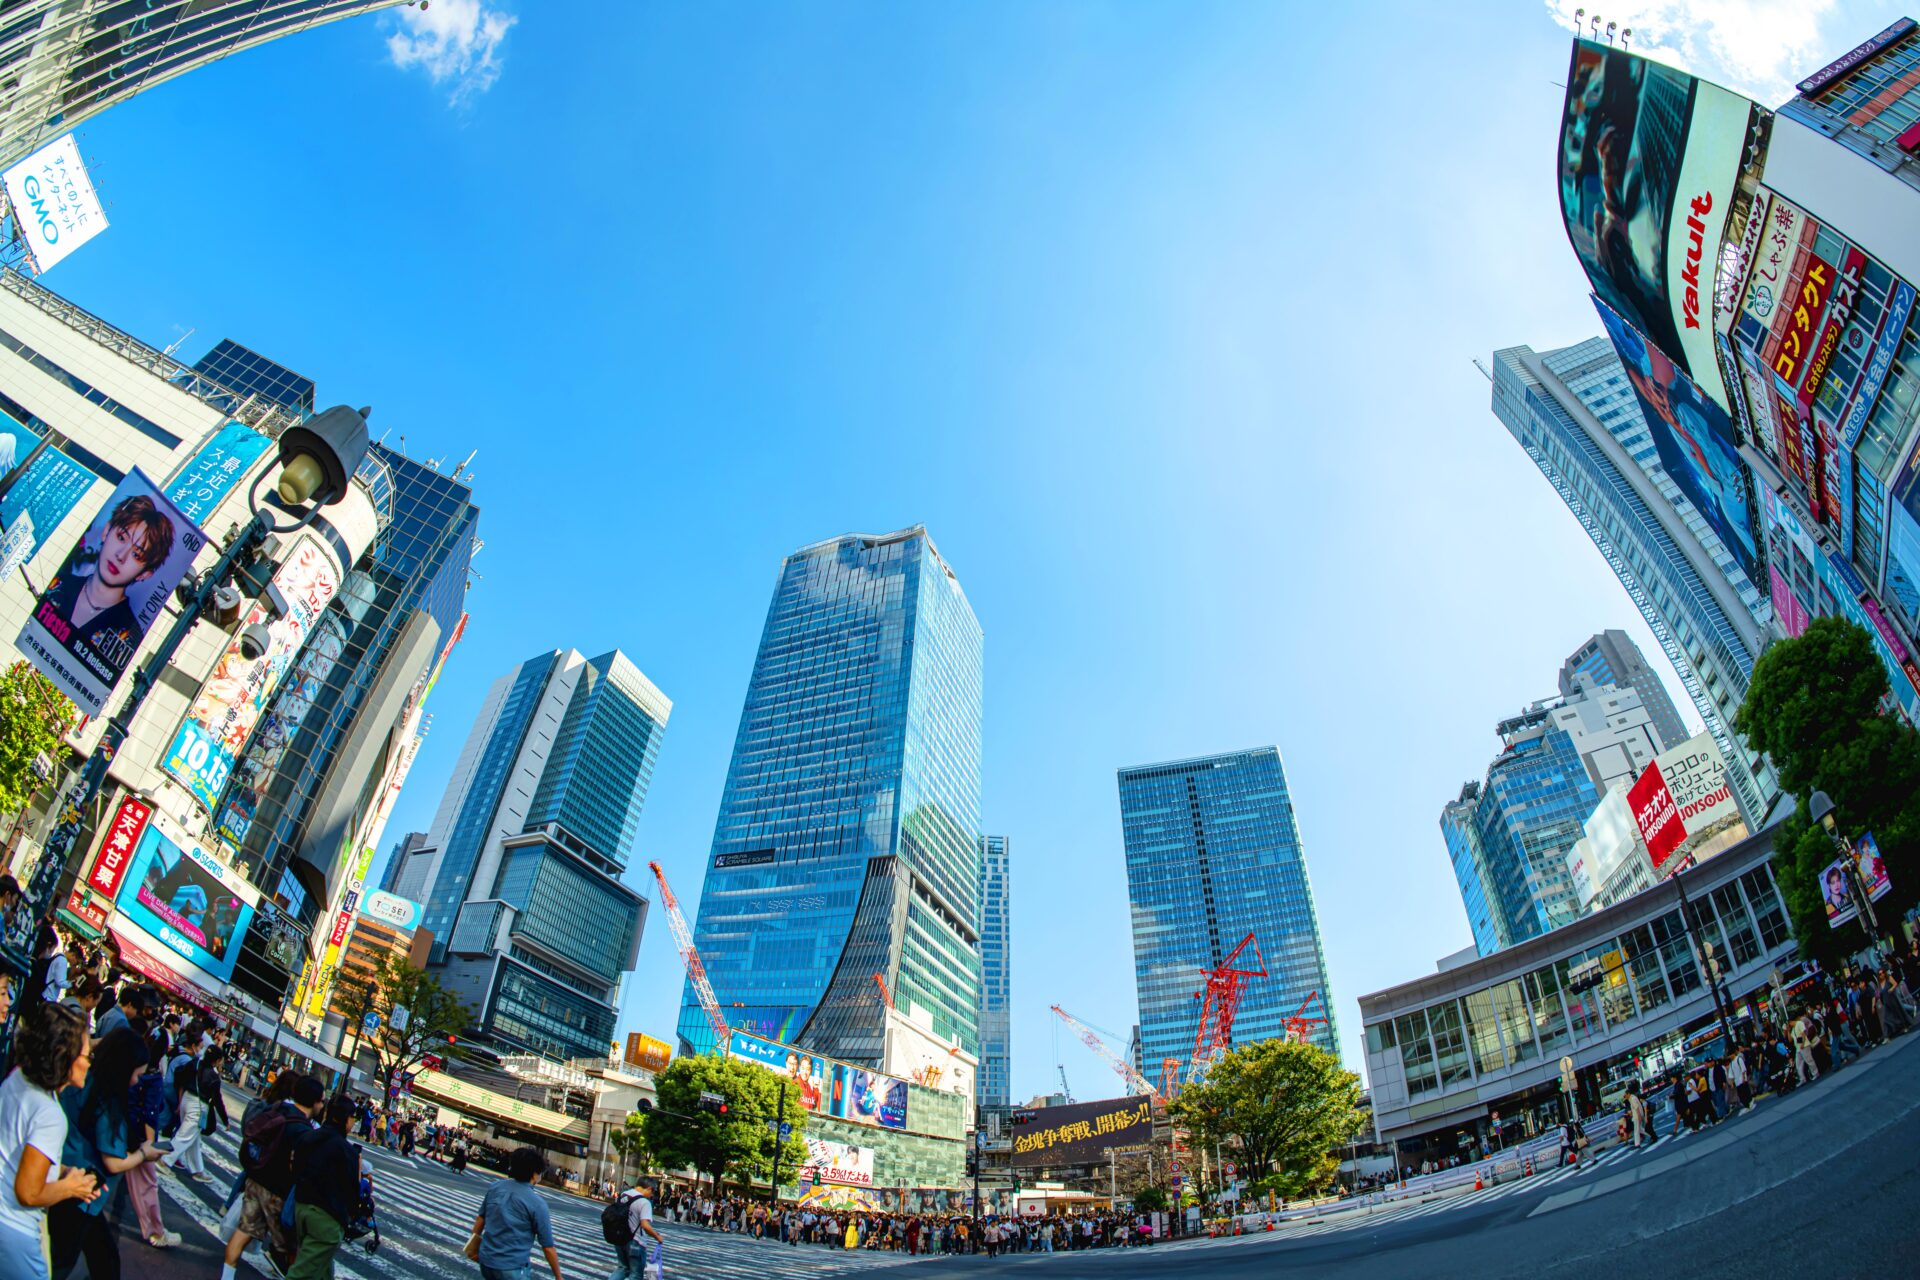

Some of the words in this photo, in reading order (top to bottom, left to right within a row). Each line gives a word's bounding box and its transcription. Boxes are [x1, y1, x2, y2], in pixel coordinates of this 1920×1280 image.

[24, 175, 59, 245] GMO
[42, 165, 74, 232] インターネット
[54, 155, 88, 226] すべての人に
[1682, 190, 1713, 330] Yakult
[1723, 193, 1766, 314] しゃぶしゃぶバイキング
[1759, 203, 1795, 283] しゃぶ葉
[1775, 264, 1827, 381] コンタクト
[1831, 264, 1862, 328] ガスト
[1862, 286, 1911, 400] 英会話イーオン
[1845, 401, 1867, 444] AEON
[172, 446, 226, 504] スゴすぎ
[37, 601, 72, 644] Fiesta
[24, 633, 102, 709] 渋谷道玄坂商店街振興組合
[72, 638, 91, 660] 10.2
[87, 652, 115, 683] Release
[177, 729, 229, 792] 10.13
[1662, 751, 1709, 782] ココロの
[1669, 760, 1725, 795] ボリューム
[124, 803, 143, 820] 名物
[1638, 786, 1667, 832] カラオケ
[1644, 802, 1676, 844] JOYSOUND
[1681, 784, 1734, 822] JOYSOUN
[95, 813, 139, 889] 天津甘栗
[833, 1079, 843, 1100] N
